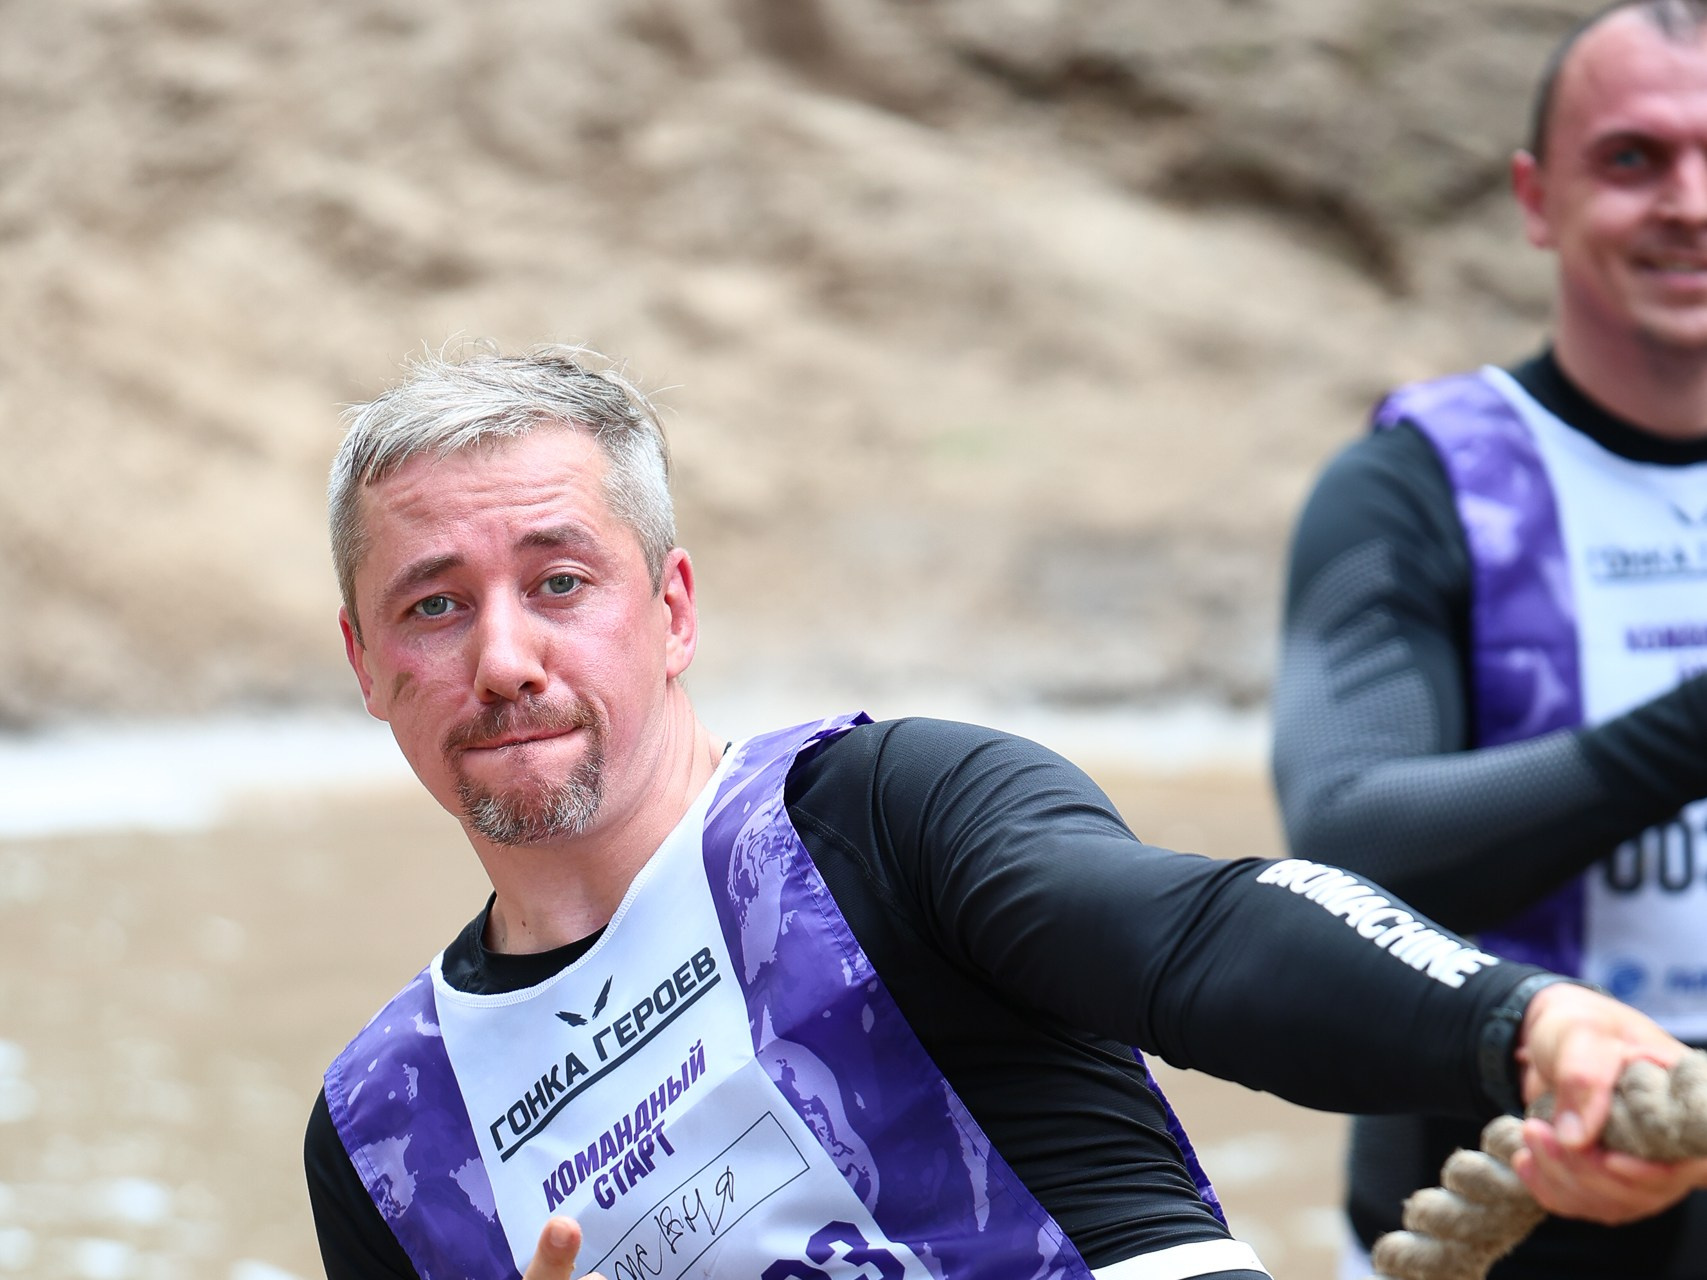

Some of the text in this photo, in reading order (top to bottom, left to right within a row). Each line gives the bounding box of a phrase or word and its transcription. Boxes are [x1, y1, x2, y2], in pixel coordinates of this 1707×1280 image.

[1606, 814, 1707, 893] 00
[489, 946, 717, 1150] ГОНКА ГЕРОЕВ
[542, 1039, 706, 1212] КОМАНДНЫЙ
[593, 1120, 676, 1210] СТАРТ
